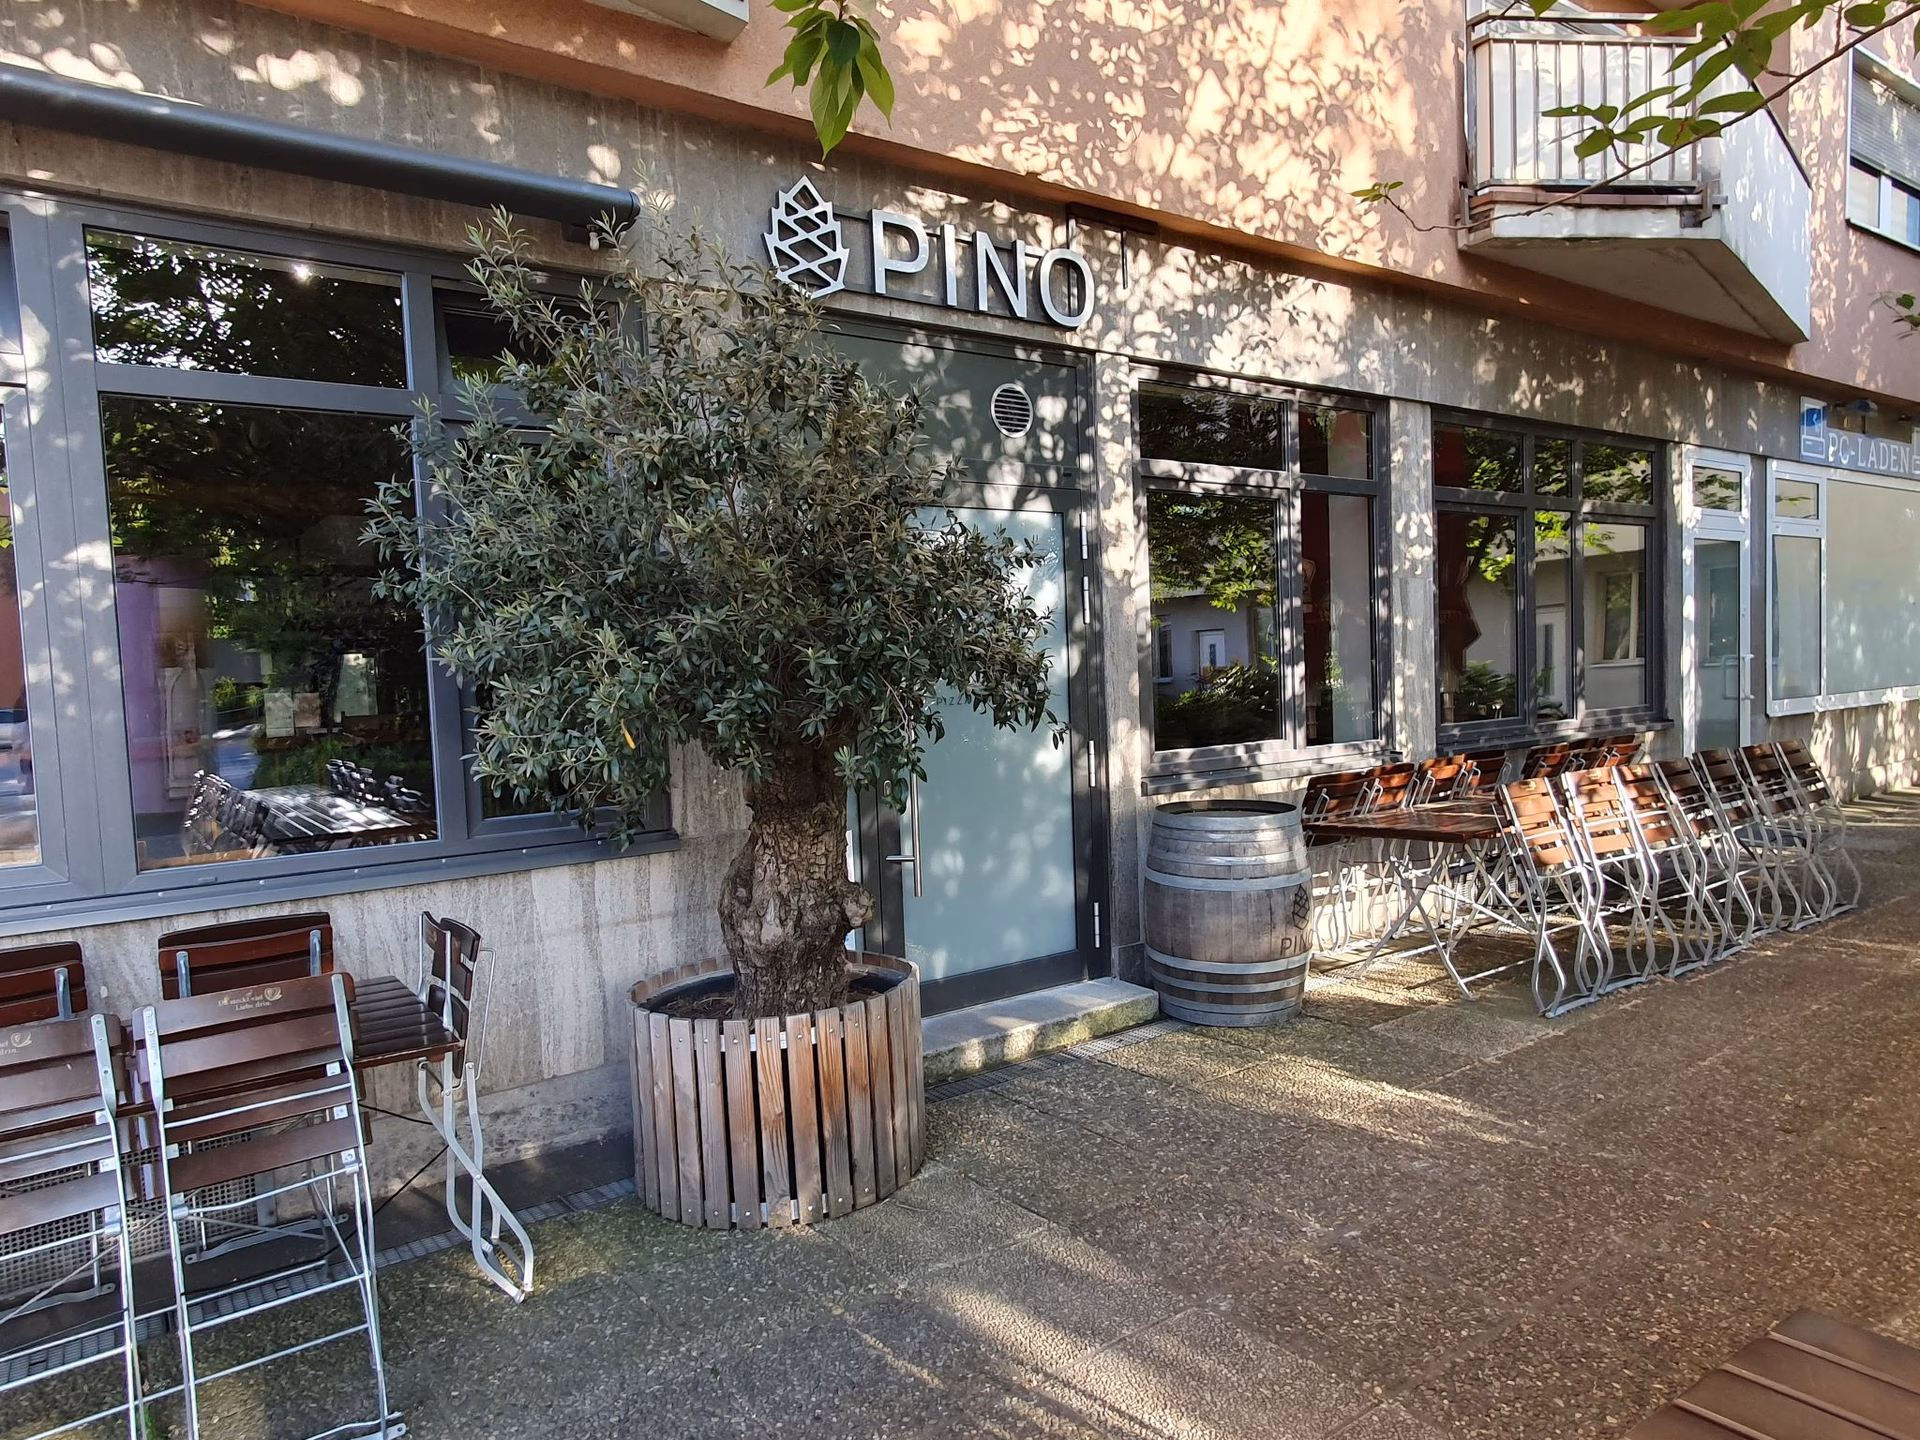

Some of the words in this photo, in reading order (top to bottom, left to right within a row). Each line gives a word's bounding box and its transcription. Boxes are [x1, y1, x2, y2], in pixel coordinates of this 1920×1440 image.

[869, 208, 1095, 328] PINO
[1828, 432, 1910, 474] PC-LADEN
[235, 1003, 253, 1011] Liebe
